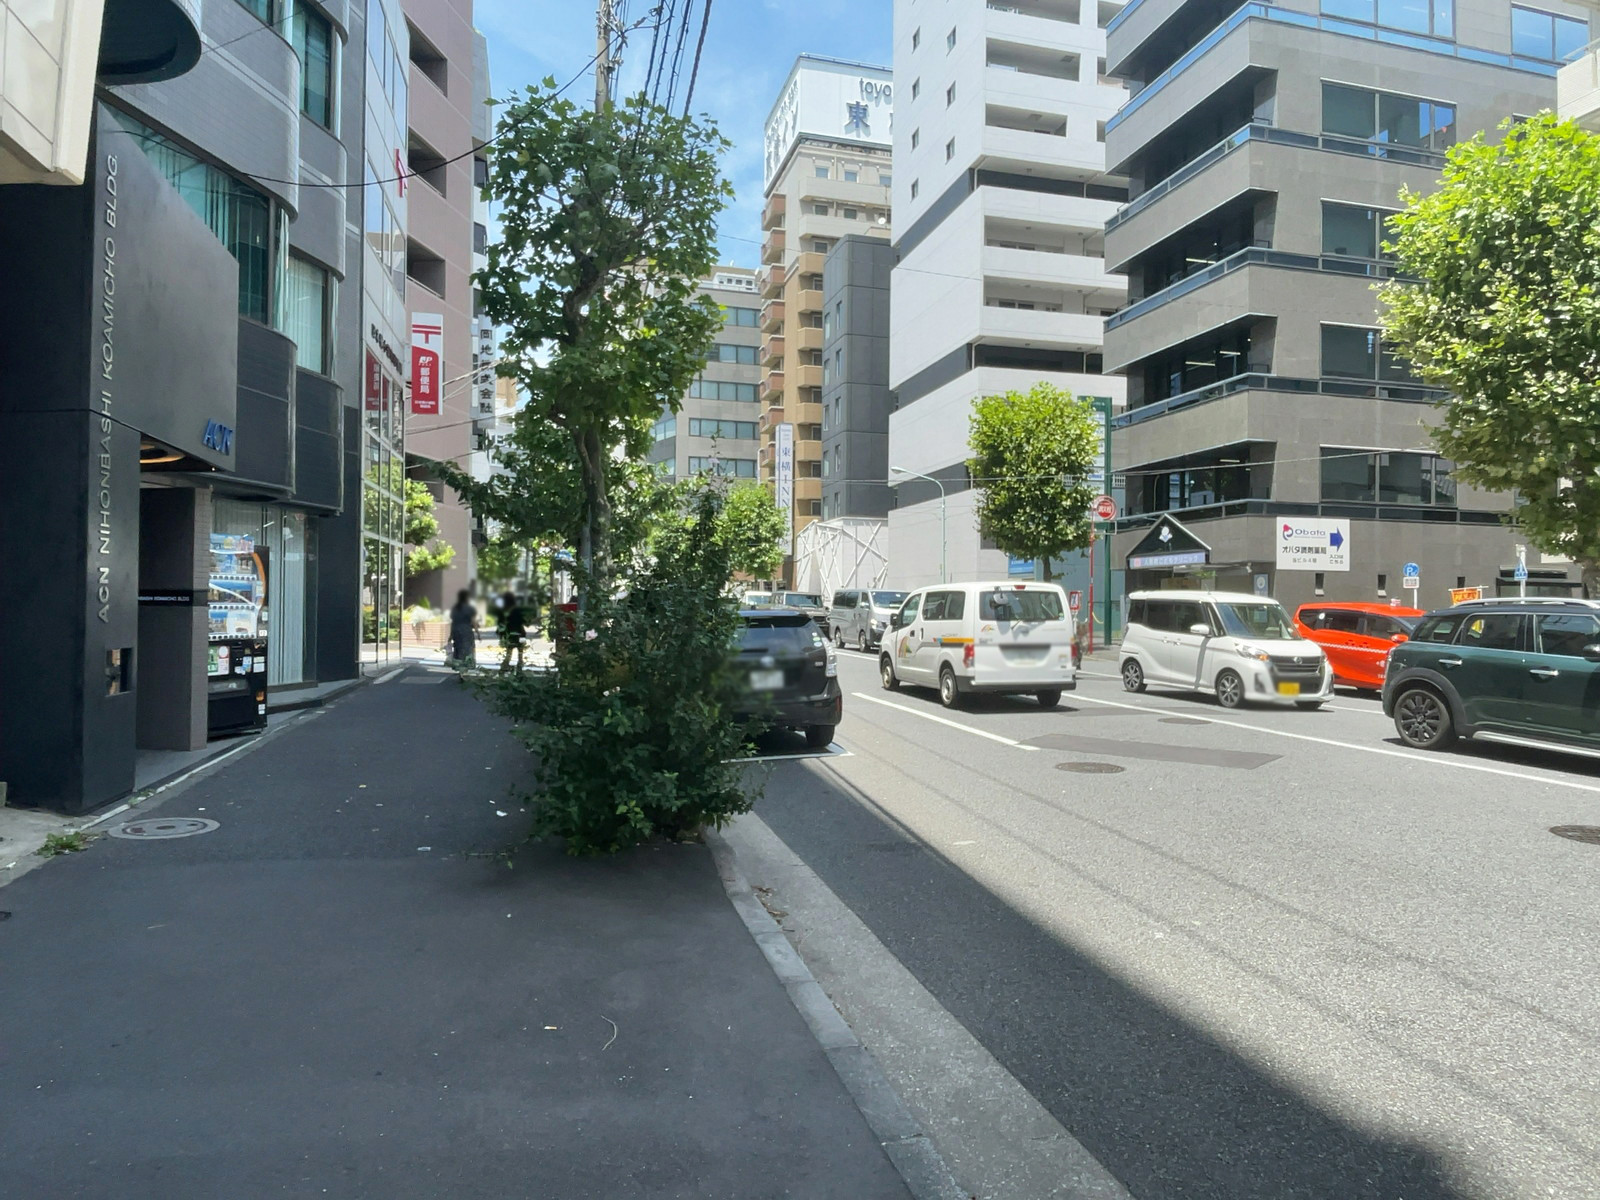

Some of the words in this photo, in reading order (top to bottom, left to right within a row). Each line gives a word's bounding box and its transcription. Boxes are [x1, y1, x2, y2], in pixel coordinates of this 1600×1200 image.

[107, 155, 118, 228] BLDG.
[103, 237, 115, 379] KOAMICHO
[203, 418, 233, 456] ACN
[100, 391, 112, 554] NIHONBASHI
[1295, 528, 1326, 536] Obata
[98, 567, 110, 623] ACN
